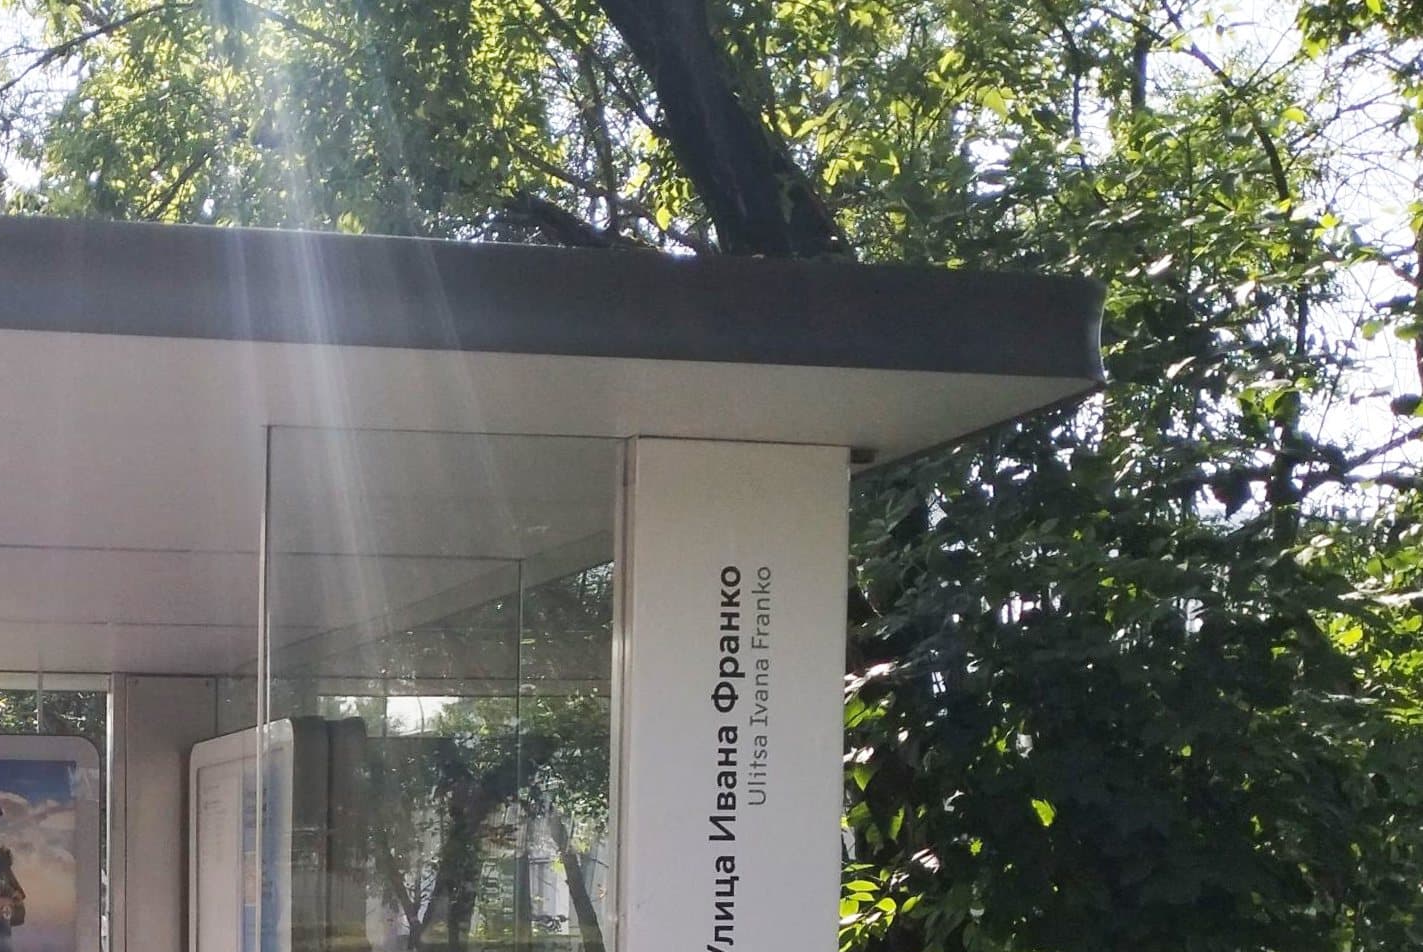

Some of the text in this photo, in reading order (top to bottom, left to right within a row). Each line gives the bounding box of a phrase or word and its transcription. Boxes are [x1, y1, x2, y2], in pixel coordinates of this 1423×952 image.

[710, 565, 746, 713] Франко
[747, 566, 772, 805] Ulitsa Ivana Franko
[708, 724, 738, 841] Ивана
